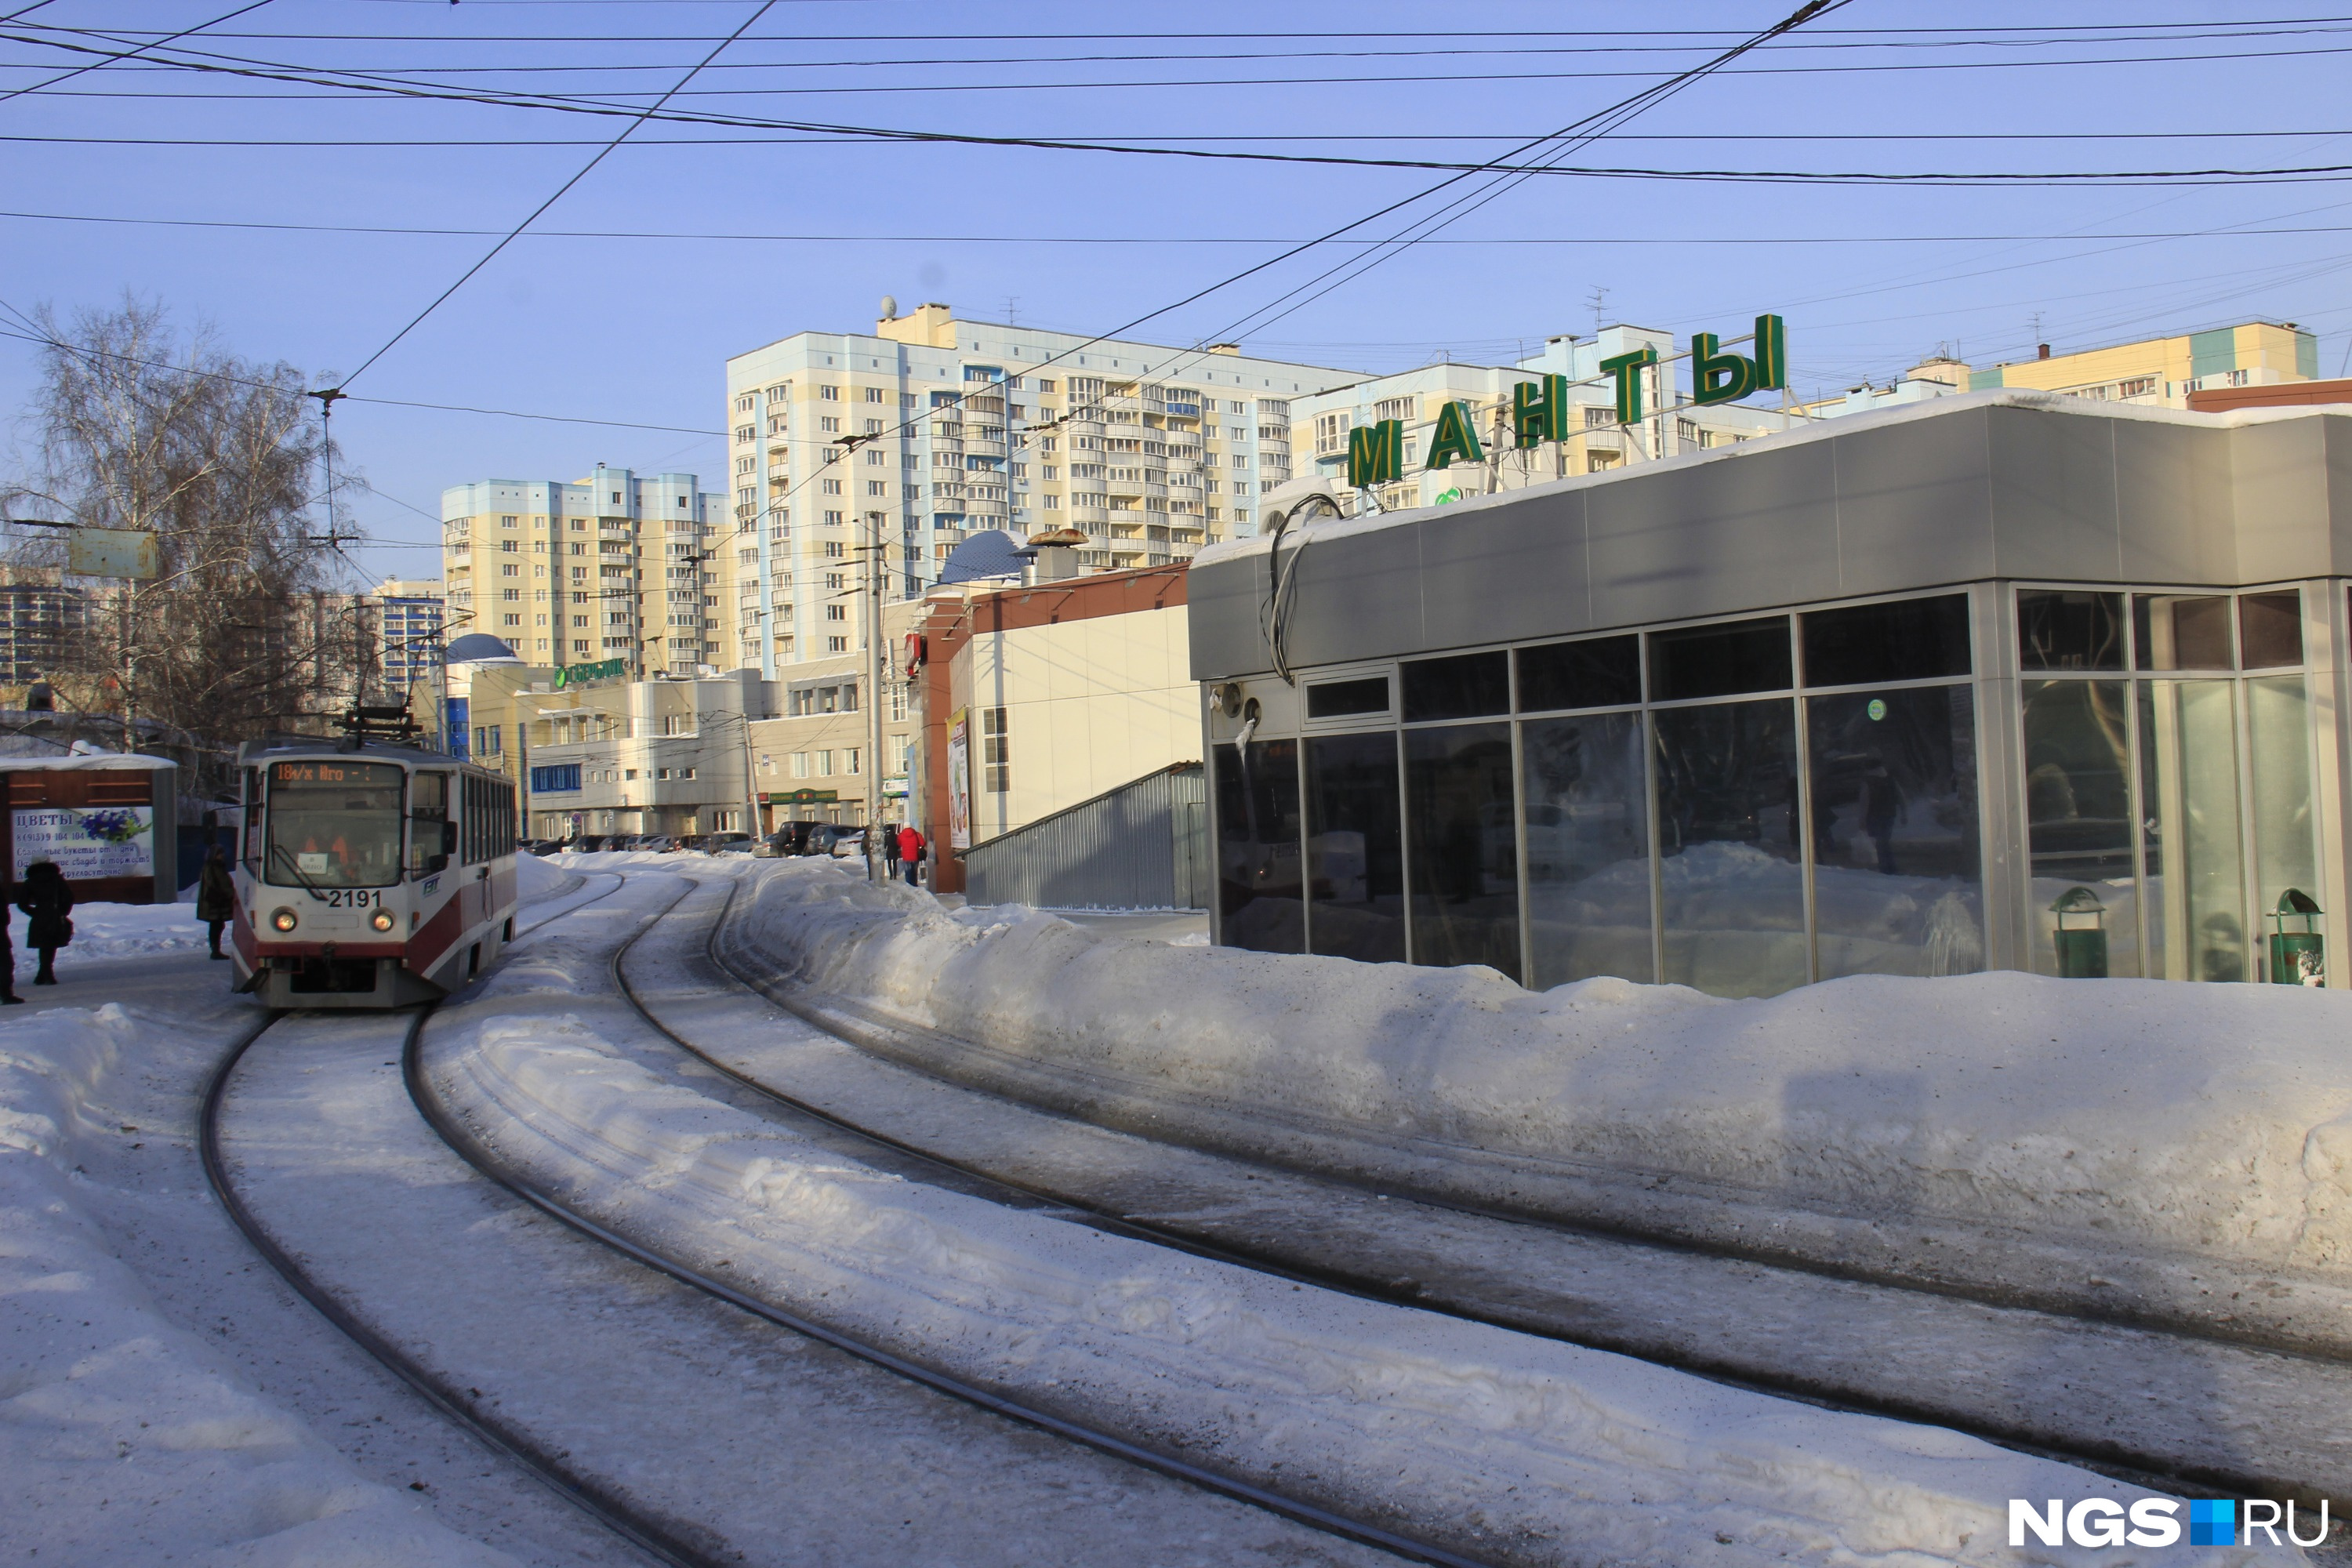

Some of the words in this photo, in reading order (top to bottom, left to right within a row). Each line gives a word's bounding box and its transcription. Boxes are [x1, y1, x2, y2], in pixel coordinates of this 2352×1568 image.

[1348, 314, 1784, 488] МАНТЫ
[16, 815, 74, 828] ЦВЕТЫ
[64, 846, 96, 855] букеты
[120, 845, 134, 855] дня
[109, 855, 150, 865] торжеств
[328, 890, 381, 908] 2191
